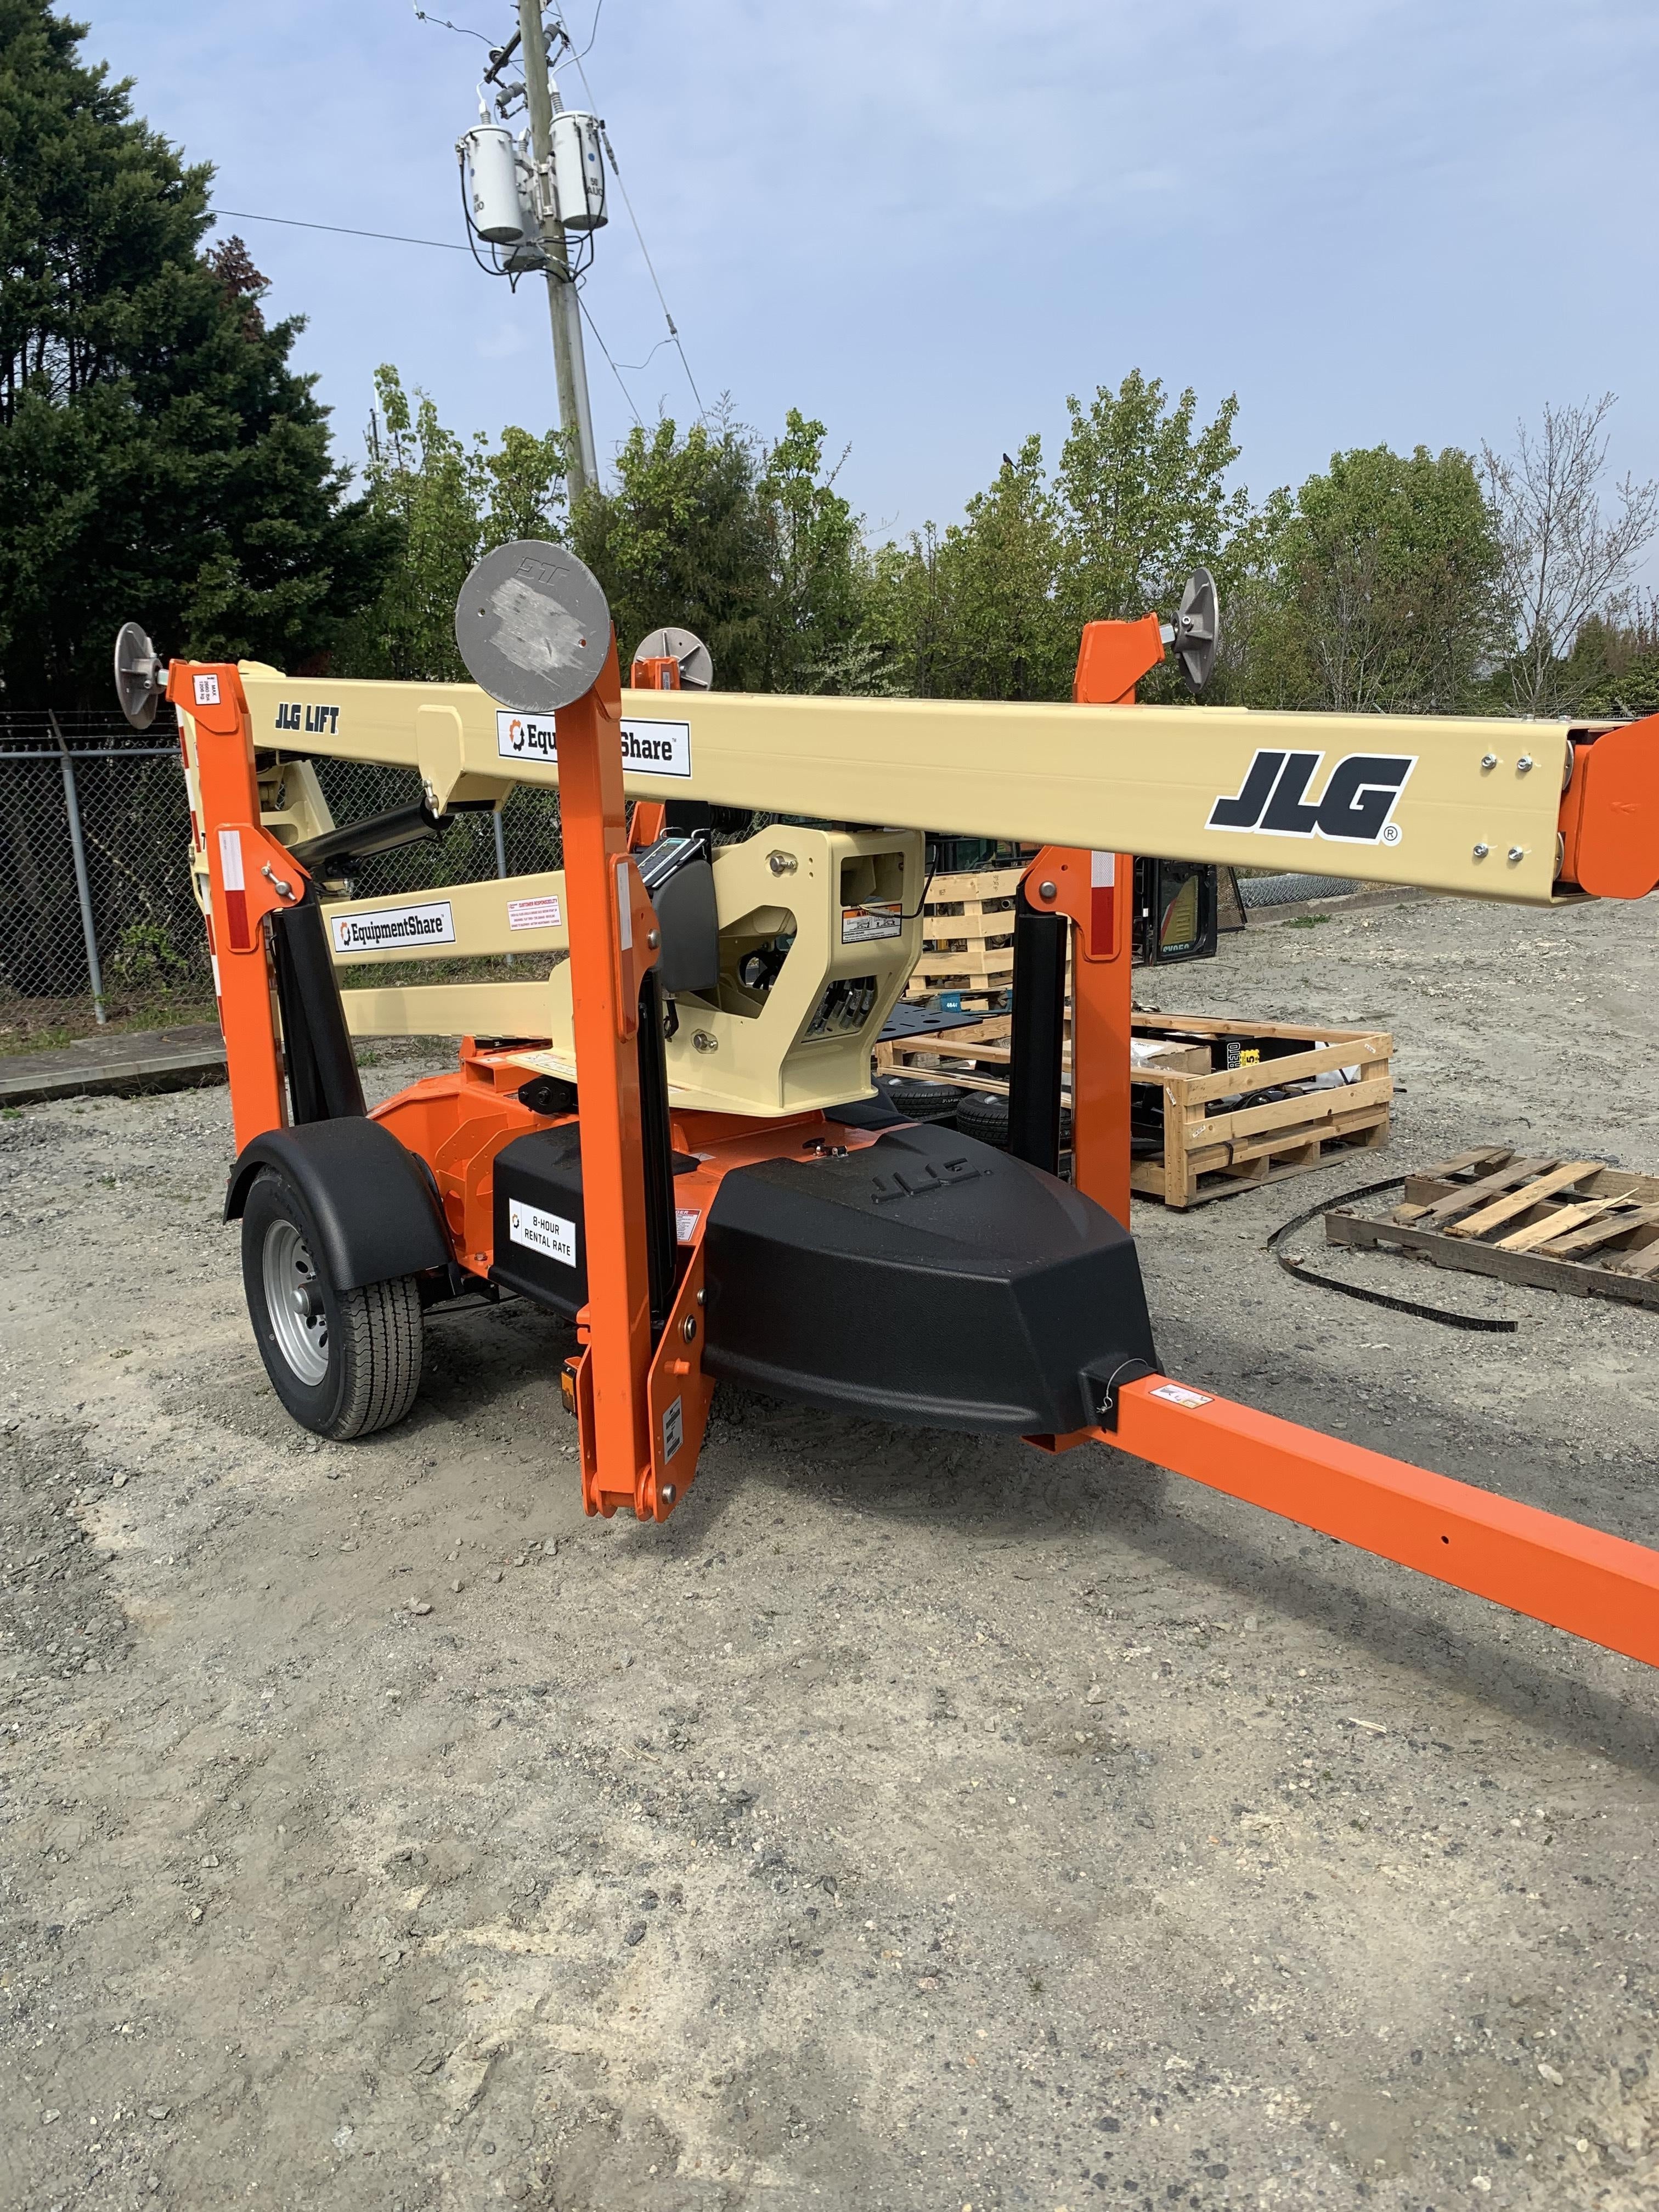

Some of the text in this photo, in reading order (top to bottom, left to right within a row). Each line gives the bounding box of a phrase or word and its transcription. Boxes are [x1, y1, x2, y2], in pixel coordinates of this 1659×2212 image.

[275, 703, 340, 734] JLG LIFT
[1209, 751, 1412, 840] JLG
[351, 915, 443, 945] EquipmentShare
[533, 1216, 560, 1235] 8-HOUR
[524, 1228, 571, 1256] RENTAL RATE
